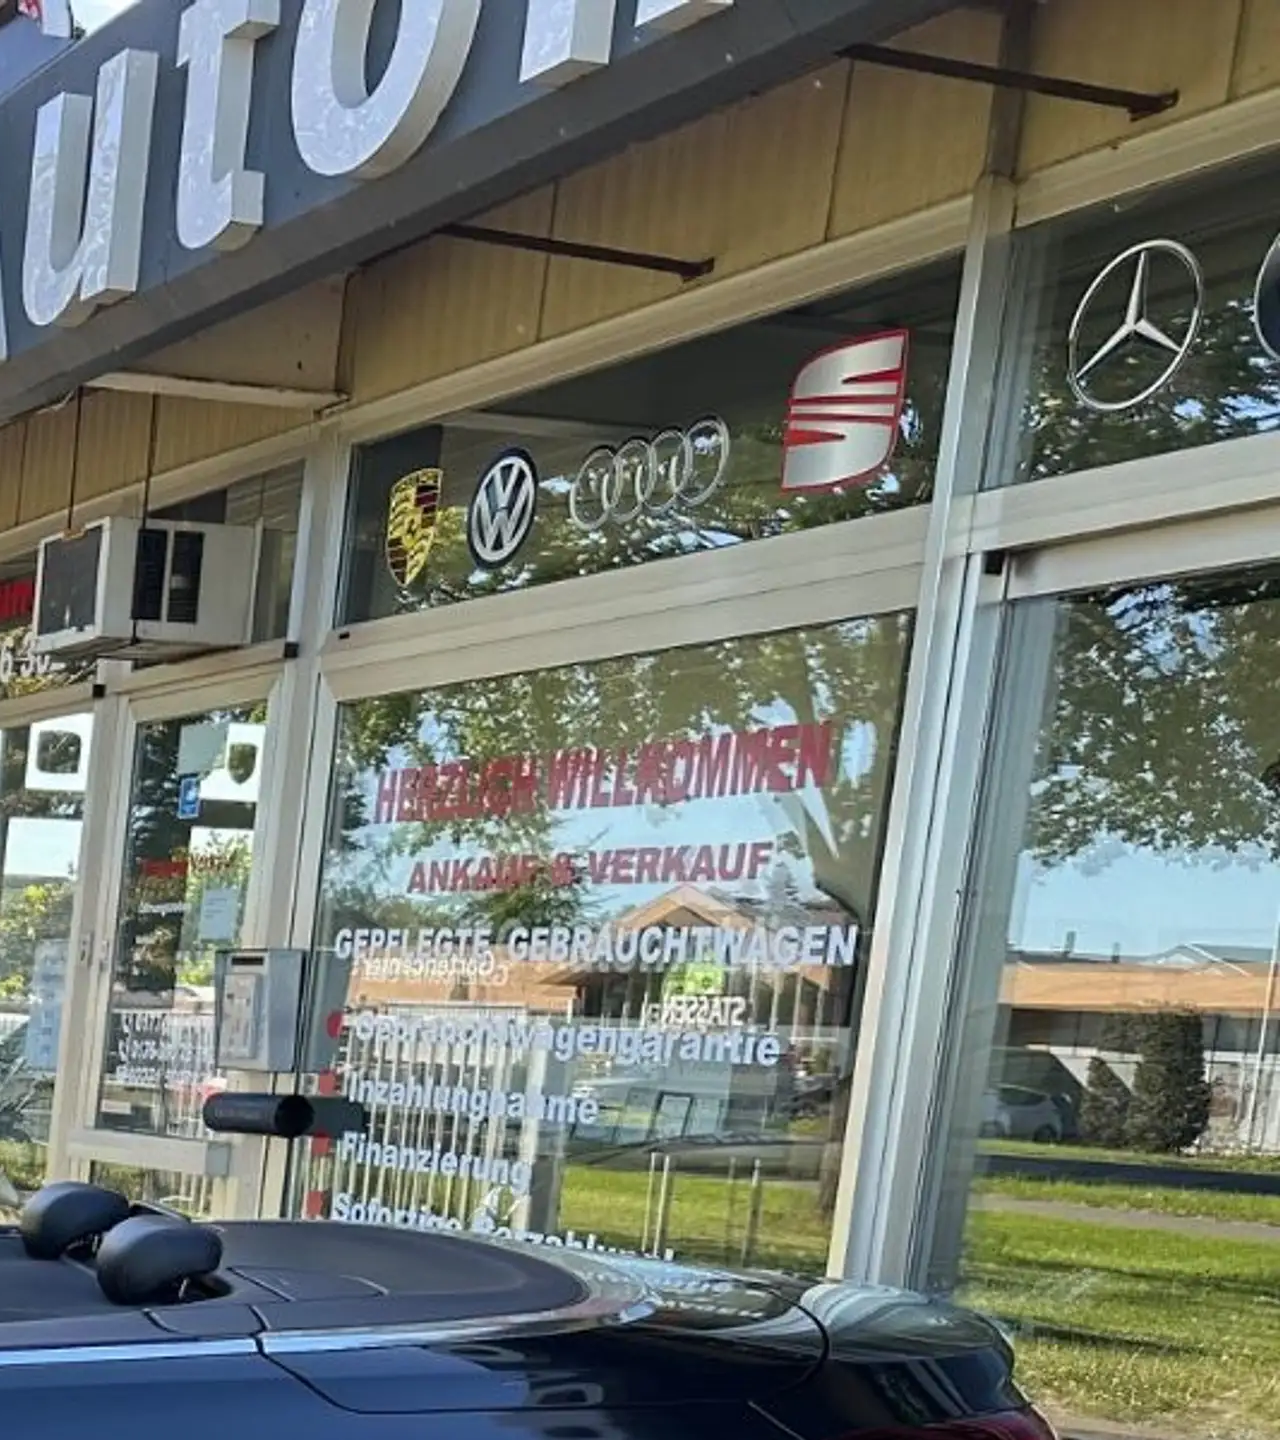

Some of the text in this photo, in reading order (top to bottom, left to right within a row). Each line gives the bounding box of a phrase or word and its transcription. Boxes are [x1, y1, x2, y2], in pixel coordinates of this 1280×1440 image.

[550, 721, 833, 810] WILLKOMMEN
[407, 854, 539, 894] ANKAUF
[589, 842, 774, 885] VERKAUF
[335, 923, 857, 966] GEPFLEGTE GEBRAUCHTWAGEN
[355, 1011, 780, 1068] Gebrauchtwagengarantie
[348, 1069, 599, 1125] Inzahlungnahme
[342, 1131, 532, 1194] Finanzierung
